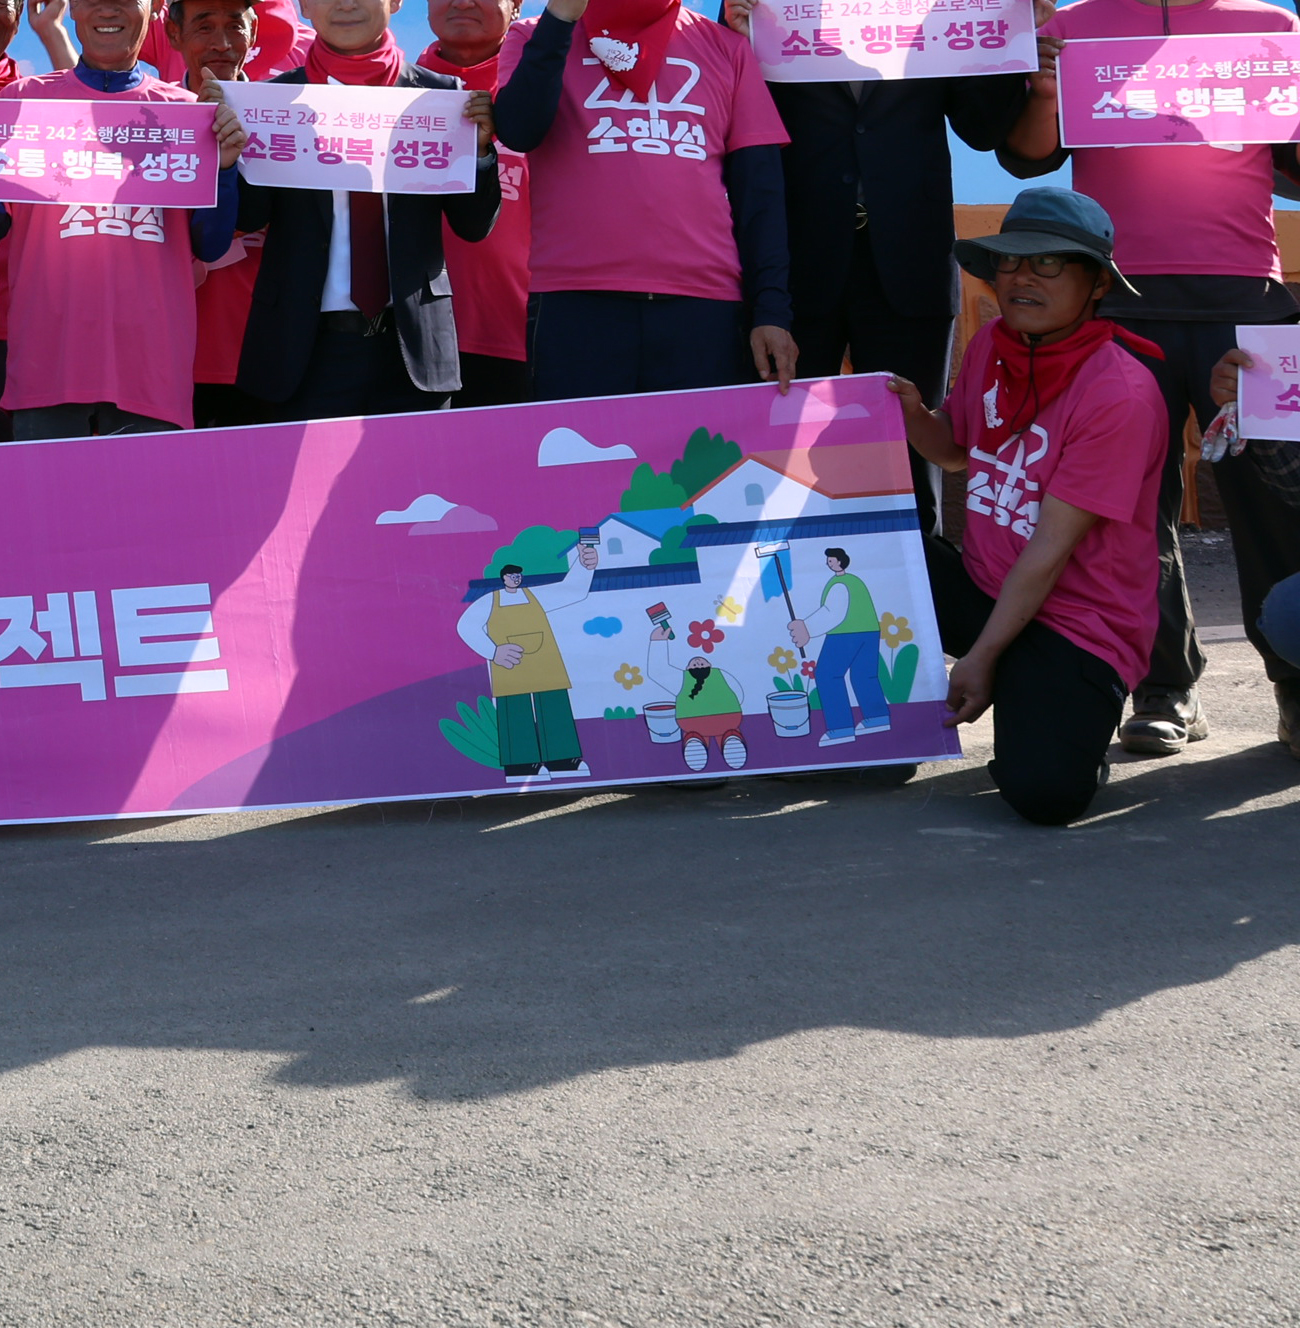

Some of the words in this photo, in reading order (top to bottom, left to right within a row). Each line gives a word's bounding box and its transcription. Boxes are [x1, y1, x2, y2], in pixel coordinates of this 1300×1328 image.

[783, 3, 834, 21] 진도군
[840, 1, 872, 17] 242
[1094, 64, 1149, 82] 진도군
[1155, 64, 1189, 79] 242
[243, 108, 291, 126] 진도군
[297, 112, 327, 126] 242
[332, 112, 447, 132] 소행성프로젝트
[46, 126, 76, 141] 242
[81, 126, 196, 145] 소행성프로젝트
[587, 117, 706, 161] 소행성
